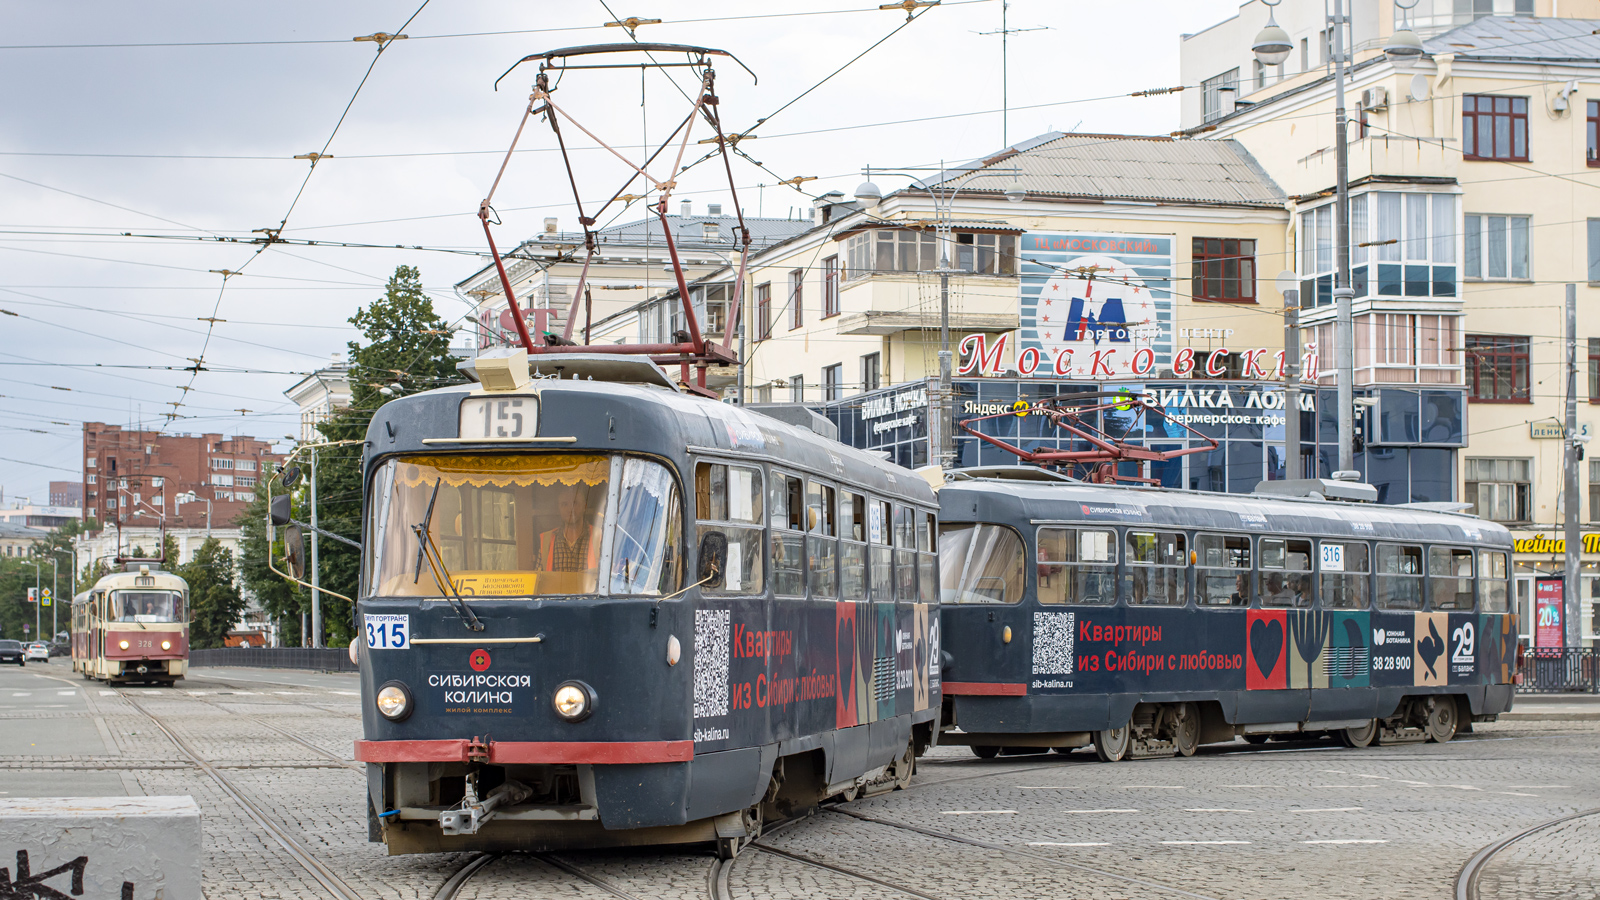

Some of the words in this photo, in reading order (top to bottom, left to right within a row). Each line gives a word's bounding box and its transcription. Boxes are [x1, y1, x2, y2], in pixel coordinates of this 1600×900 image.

[1034, 238, 1050, 250] ТЦ
[1053, 239, 1158, 253] «МОСКОВСКИЙ»
[1180, 328, 1234, 339] ЦЕНТР
[1142, 388, 1234, 408] ВИЛКА
[964, 400, 1011, 415] Яндекс
[479, 401, 522, 437] 15
[1256, 413, 1286, 428] кафе
[1581, 424, 1588, 436] 5
[1513, 533, 1566, 553] мейна
[1583, 533, 1600, 554] П
[1323, 546, 1340, 562] 316
[366, 623, 406, 648] 315
[1079, 621, 1162, 647] Квартиры
[138, 640, 152, 648] 328
[734, 623, 793, 667] Квартиры
[1452, 622, 1474, 663] 29
[1078, 654, 1100, 672] из
[1104, 650, 1164, 676] Сибири
[1168, 655, 1176, 670] с
[1179, 650, 1243, 671] любовью
[1373, 656, 1383, 670] 38
[1384, 656, 1395, 670] 28
[1395, 656, 1411, 670] 900
[733, 682, 751, 710] из
[756, 673, 793, 713] Сибири
[795, 676, 799, 702] с
[801, 667, 835, 702] любовью
[1032, 679, 1073, 689] sib-kalina.ru
[445, 706, 471, 714] жилой
[693, 728, 730, 743] sib-kalina.ru
